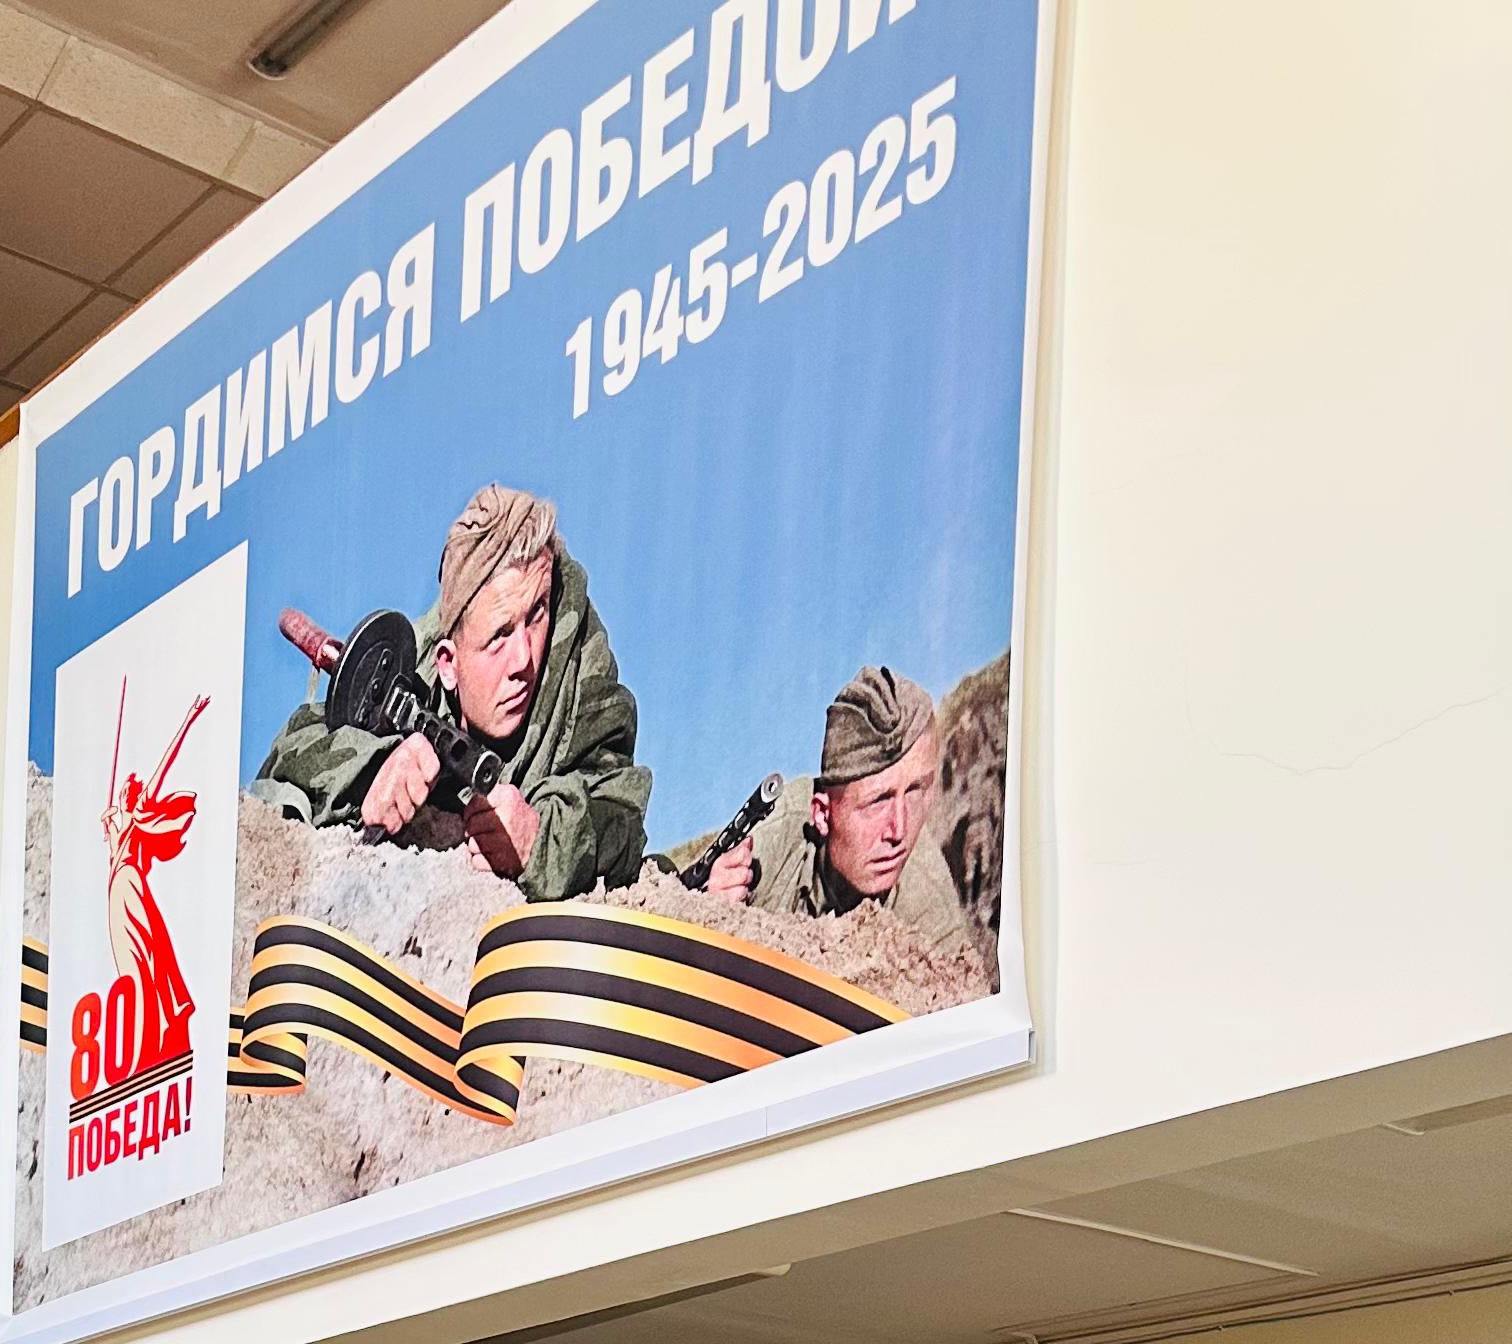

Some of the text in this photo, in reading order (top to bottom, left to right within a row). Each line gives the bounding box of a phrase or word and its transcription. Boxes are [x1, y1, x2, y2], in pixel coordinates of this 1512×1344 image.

[67, 222, 436, 600] ГОРДИМСЯ
[565, 74, 957, 420] 1945-2025
[67, 1076, 193, 1181] ПОБЕДА!
